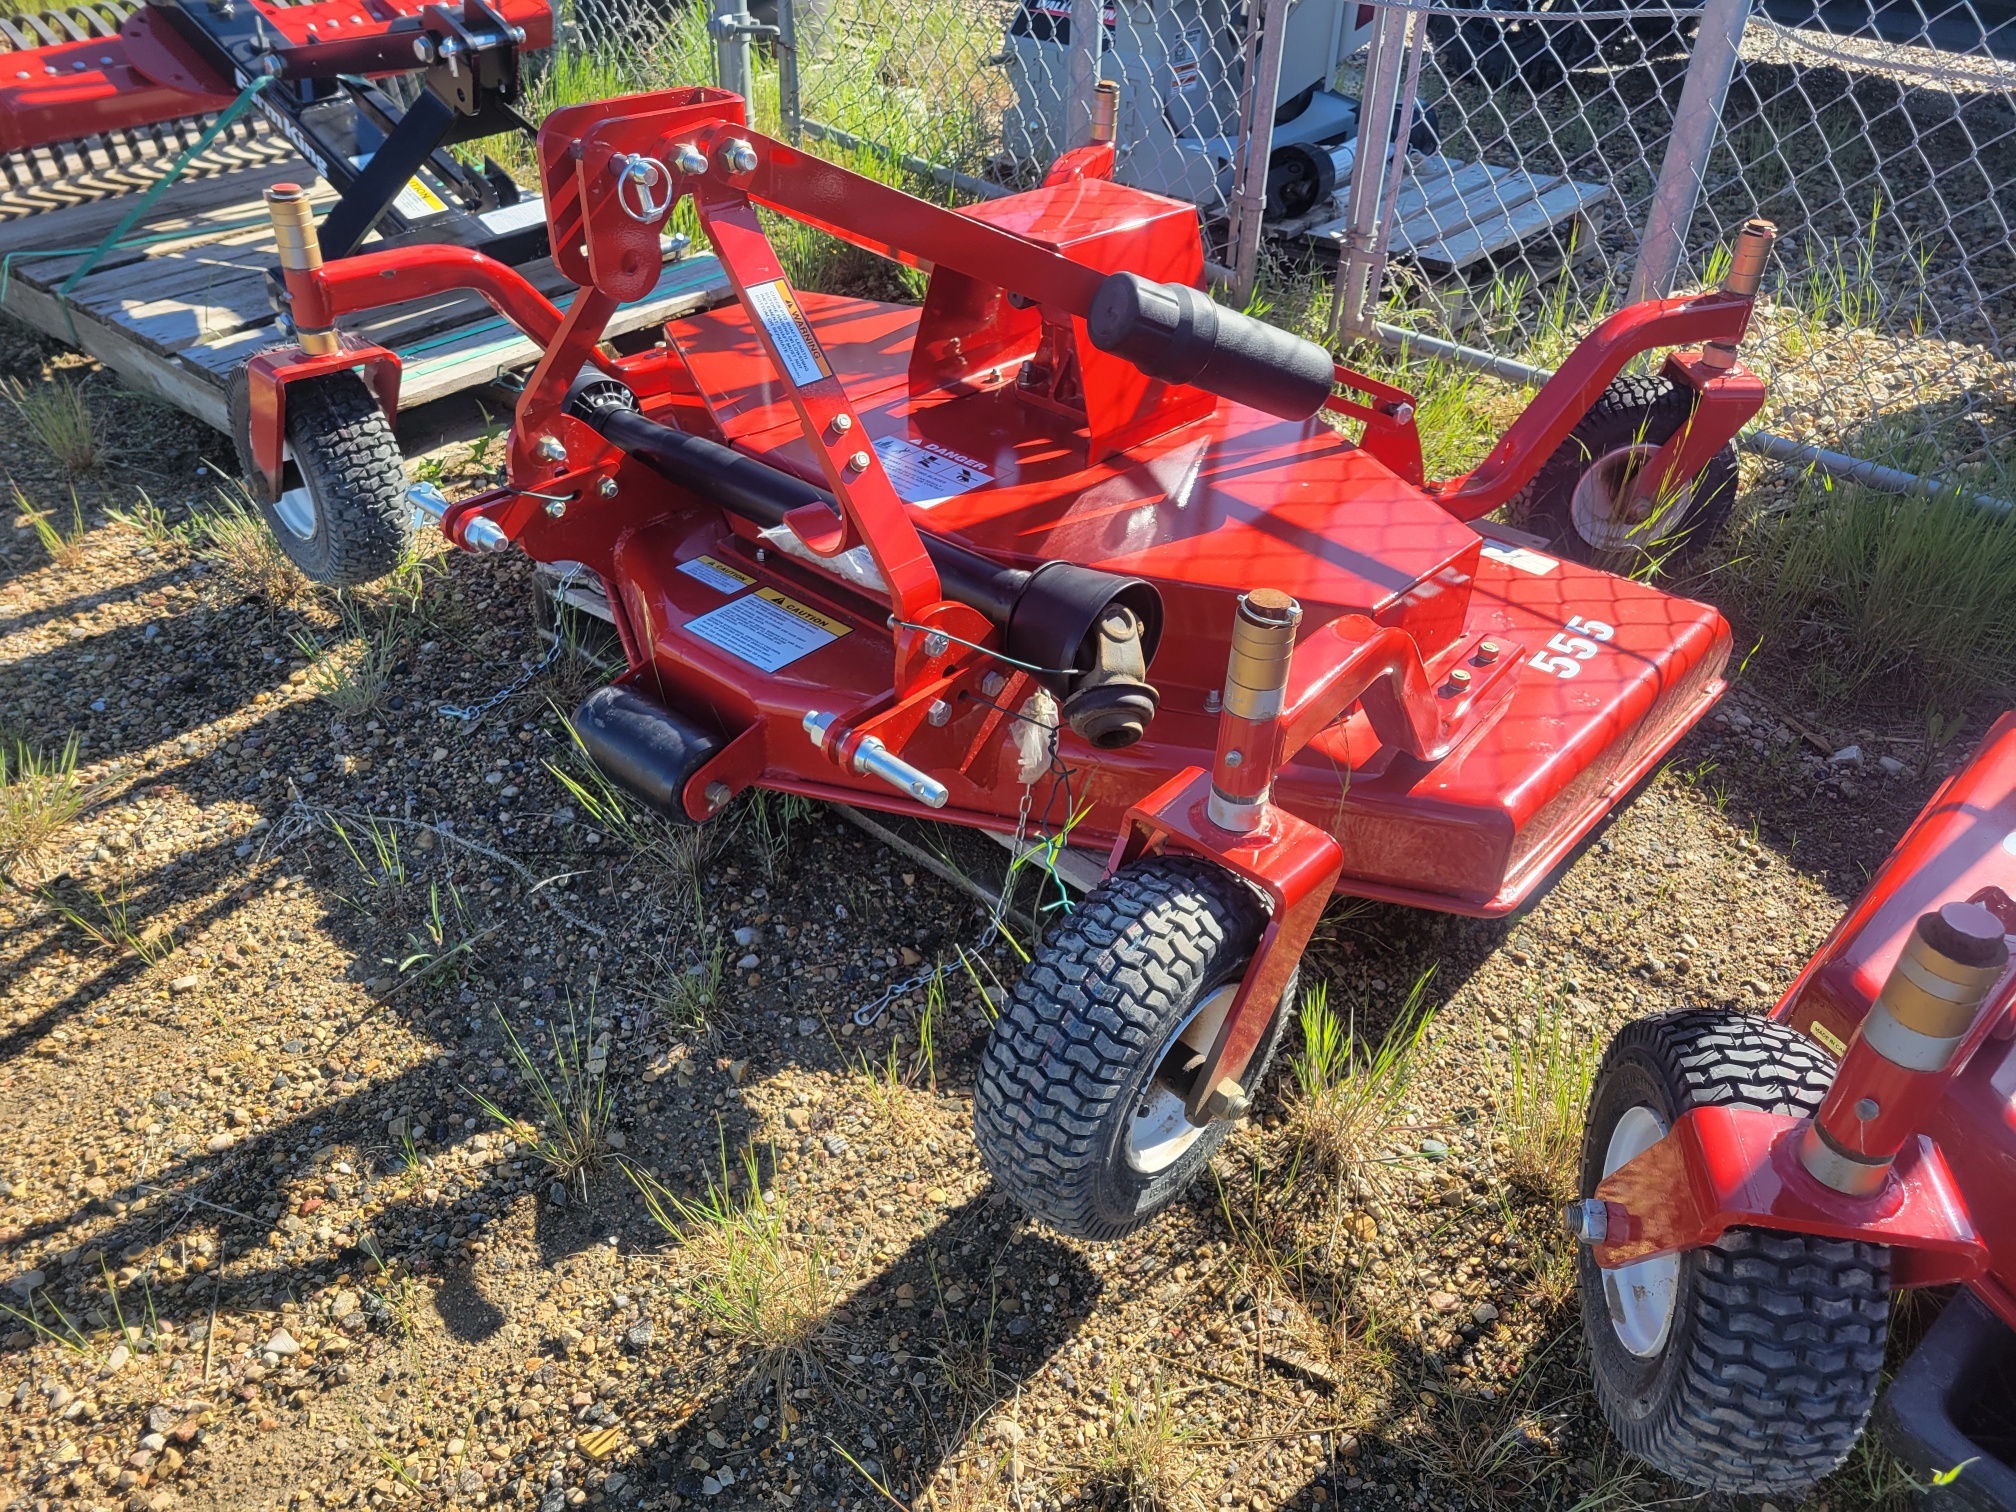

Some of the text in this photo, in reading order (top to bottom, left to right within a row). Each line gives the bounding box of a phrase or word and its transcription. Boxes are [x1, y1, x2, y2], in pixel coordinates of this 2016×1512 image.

[786, 321, 797, 338] SHAFT
[795, 338, 808, 360] LENGTH
[792, 310, 821, 359] WARNING
[794, 358, 802, 369] NOT
[924, 443, 988, 470] DANGER
[716, 564, 748, 582] CAUTION
[786, 604, 829, 627] CAUTION
[1527, 615, 1616, 679] 555
